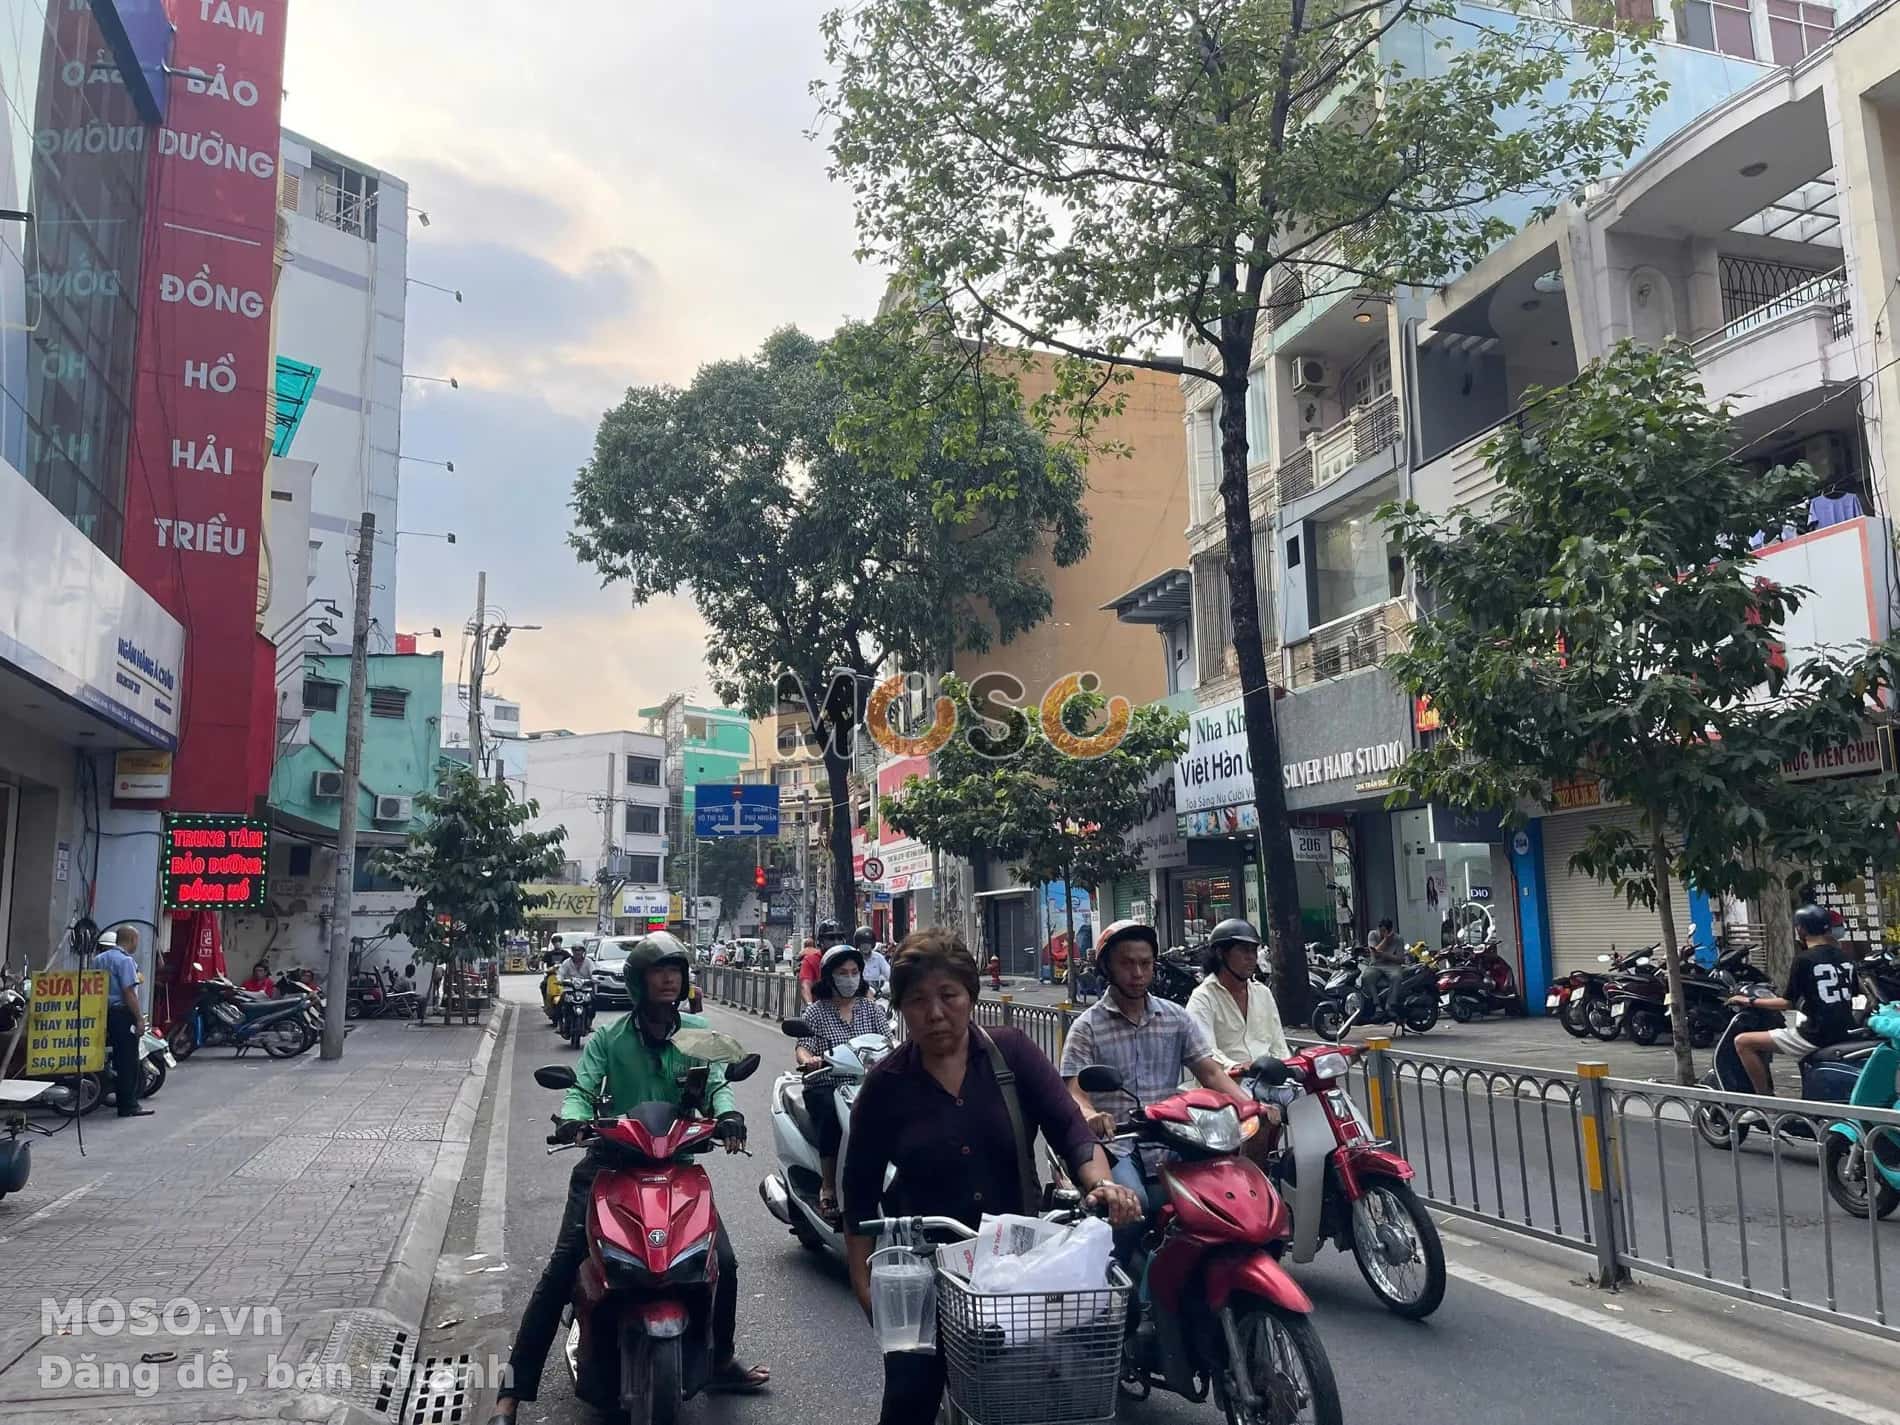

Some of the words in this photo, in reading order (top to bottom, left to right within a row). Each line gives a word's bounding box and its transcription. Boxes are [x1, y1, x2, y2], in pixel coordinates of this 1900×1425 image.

[187, 64, 258, 107] BẢO
[158, 128, 274, 179] DƯỠNG
[160, 264, 265, 319] ĐỒNG
[184, 352, 237, 394] HỒ
[172, 435, 233, 476] HẢI
[154, 512, 246, 556] TRIỀU
[1197, 716, 1222, 744] Nha
[1181, 756, 1210, 789] Việt
[1213, 750, 1243, 781] Hàn
[1283, 758, 1322, 789] SILVER
[1323, 751, 1354, 780] HAIR
[1356, 740, 1406, 774] STUDIO
[173, 830, 226, 848] TRUNG
[229, 827, 263, 848] TÂM
[1300, 838, 1321, 851] 206
[171, 851, 205, 875] BẢO
[34, 1019, 61, 1031] THAY
